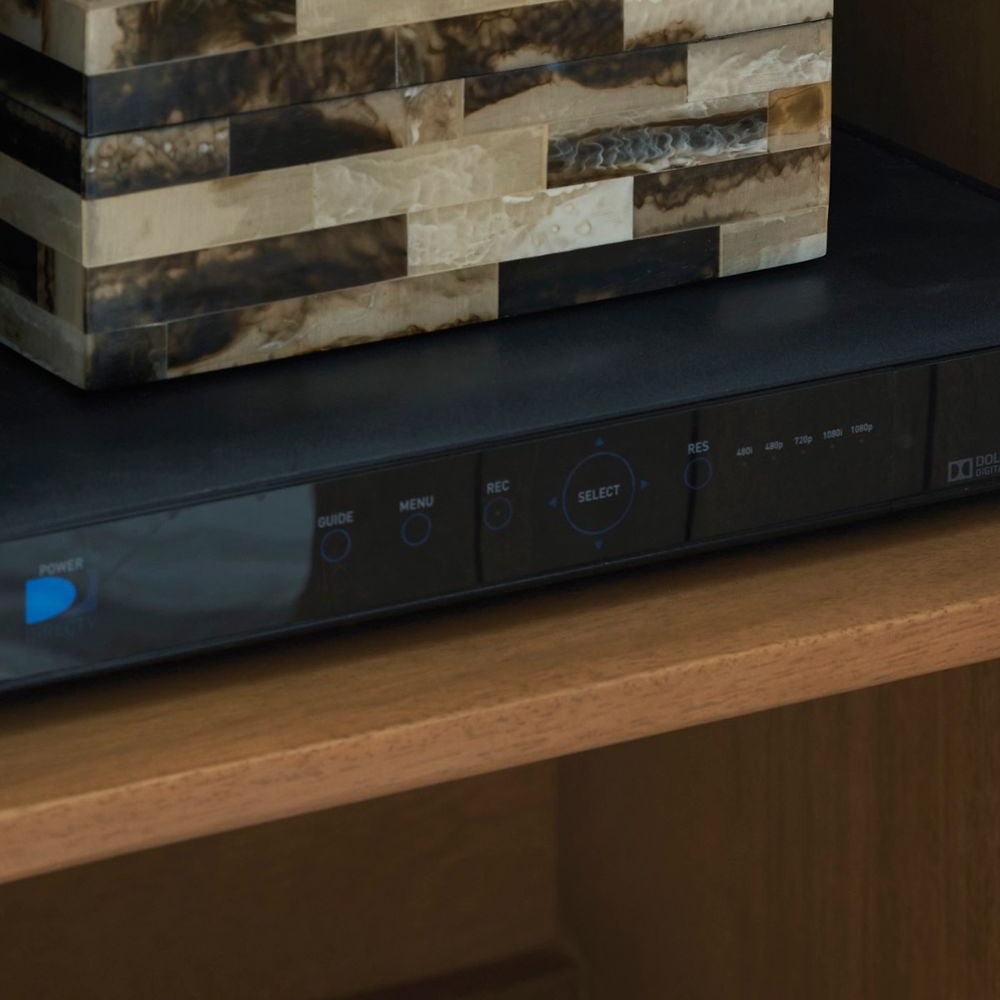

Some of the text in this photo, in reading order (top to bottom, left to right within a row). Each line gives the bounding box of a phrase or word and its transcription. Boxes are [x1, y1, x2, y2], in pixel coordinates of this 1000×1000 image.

[794, 435, 814, 446] 720p
[850, 423, 874, 435] 1080p
[687, 440, 710, 455] RES
[486, 480, 511, 495] REC
[577, 484, 621, 503] SELECT
[398, 495, 435, 513] MENU
[317, 510, 354, 529] GUIDE
[38, 557, 84, 577] POWER
